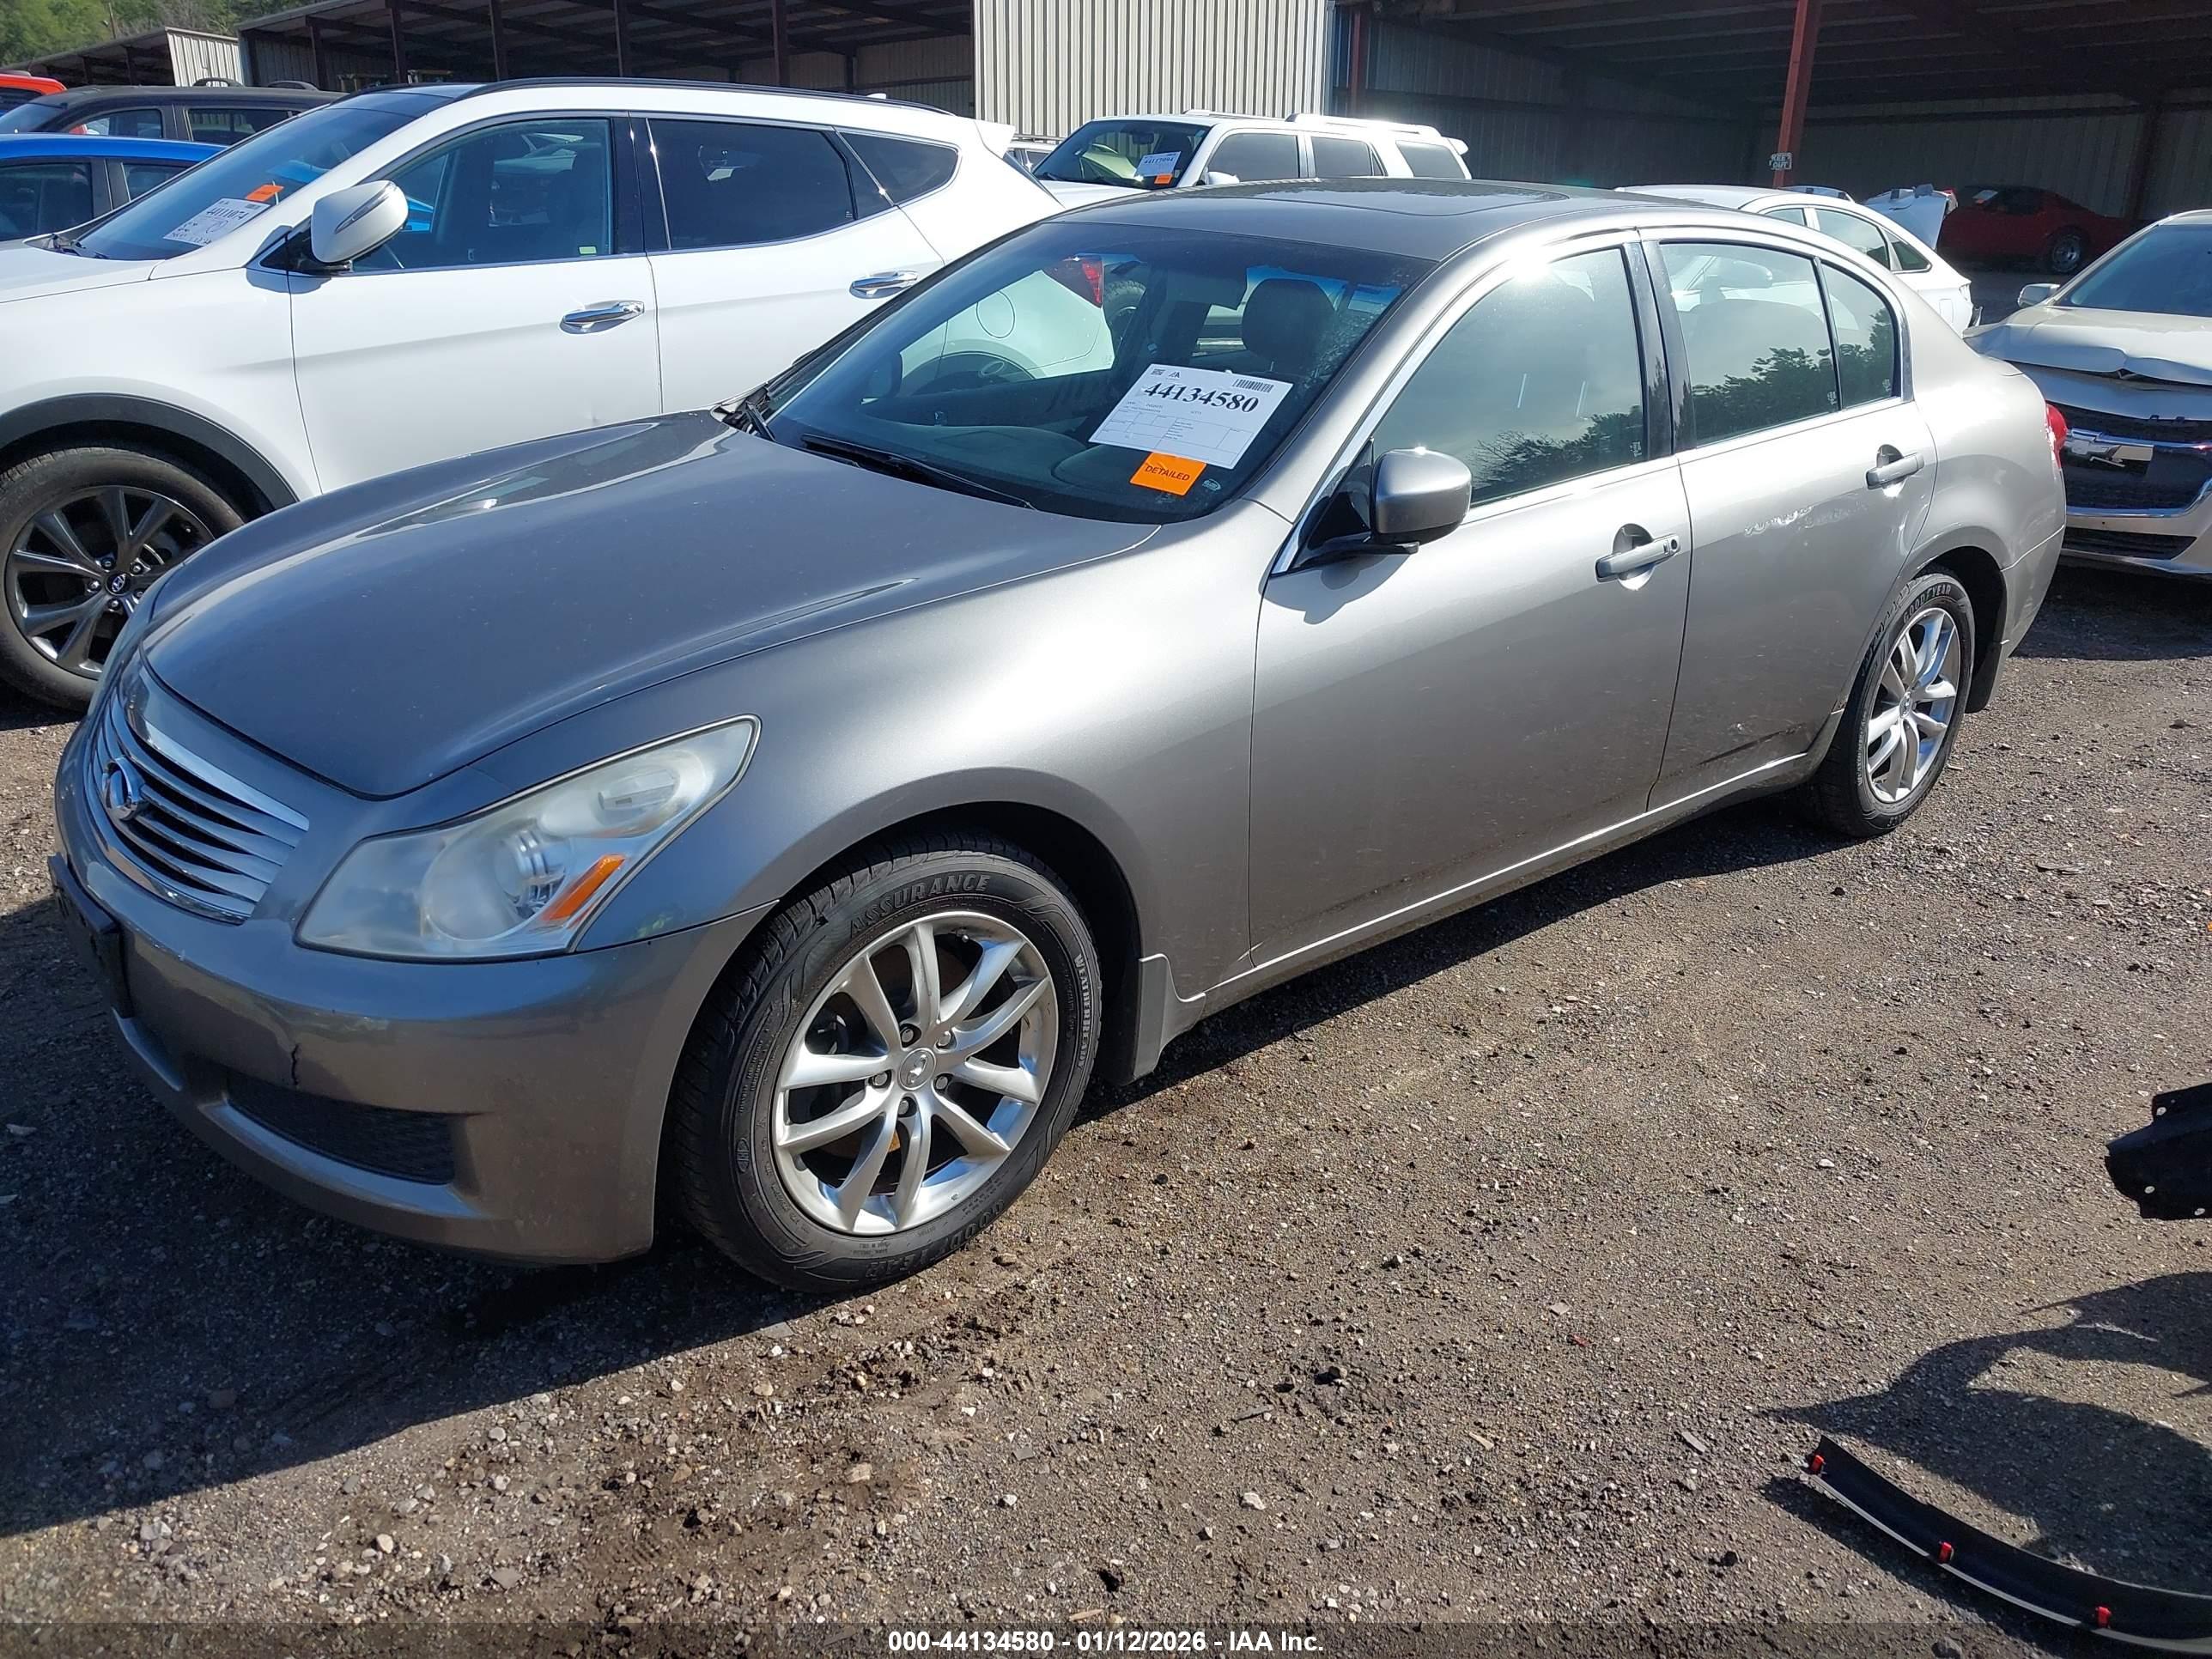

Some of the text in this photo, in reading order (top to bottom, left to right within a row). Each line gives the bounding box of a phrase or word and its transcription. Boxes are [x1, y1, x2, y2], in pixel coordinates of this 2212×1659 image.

[1143, 382, 1259, 413] 44134580
[1145, 465, 1191, 482] DETAILED
[850, 873, 990, 939] ASSURANCE
